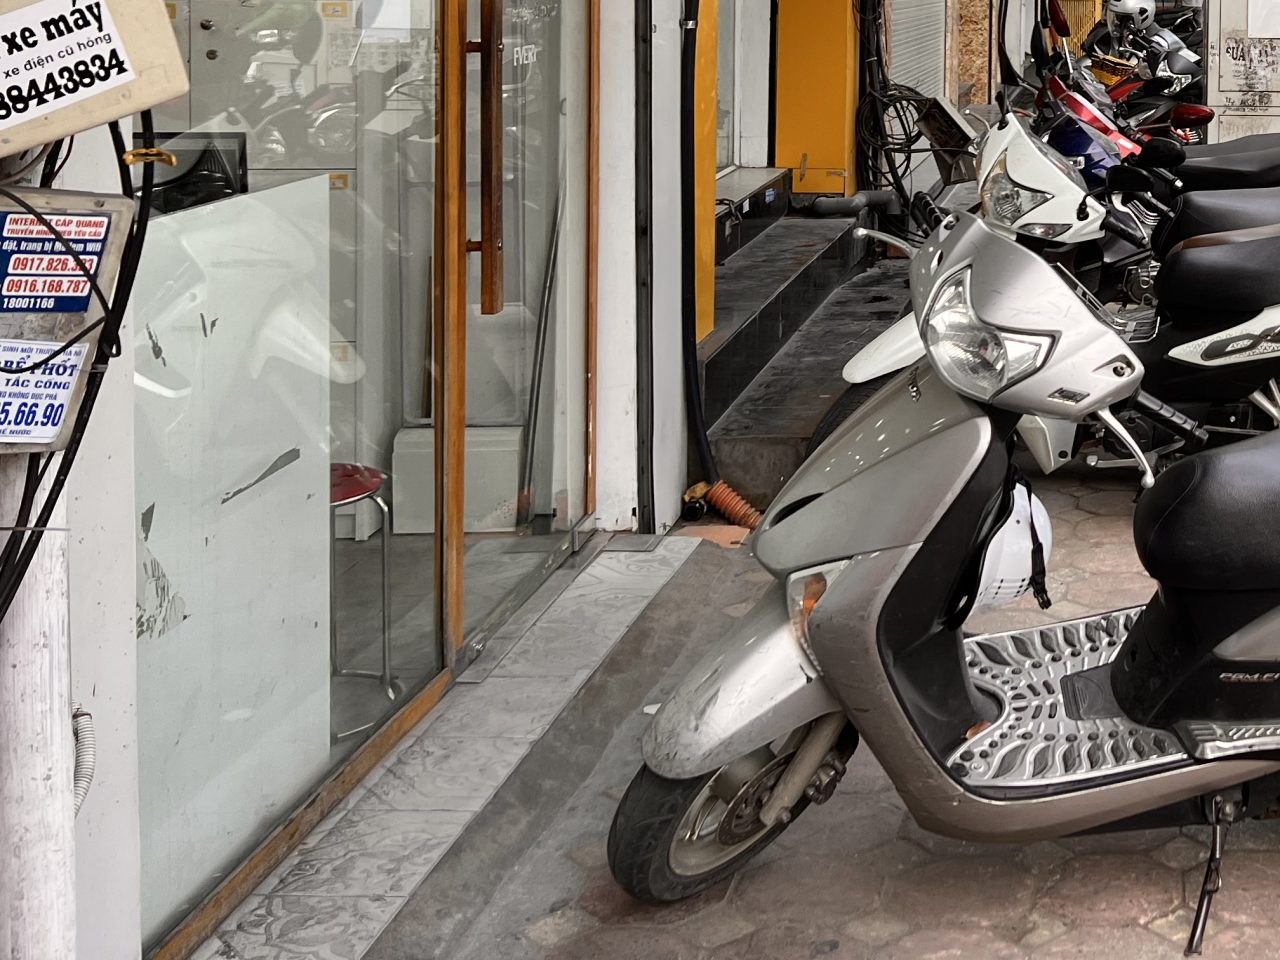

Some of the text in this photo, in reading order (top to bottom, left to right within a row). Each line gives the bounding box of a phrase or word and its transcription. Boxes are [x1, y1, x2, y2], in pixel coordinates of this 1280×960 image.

[1, 27, 38, 56] xe
[3, 66, 20, 79] xe
[24, 54, 54, 71] điện
[9, 217, 54, 227] INTERT
[75, 220, 105, 229] QUANG
[20, 241, 42, 252] trang
[54, 242, 84, 252] Moem
[6, 279, 89, 294] 0916.168.787
[3, 297, 55, 309] 18001166
[2, 345, 19, 353] SINH
[20, 345, 33, 354] MÔI
[35, 346, 57, 356] TRƯỜ
[8, 390, 29, 399] KHÔNG
[0, 401, 65, 427] 5.66.90
